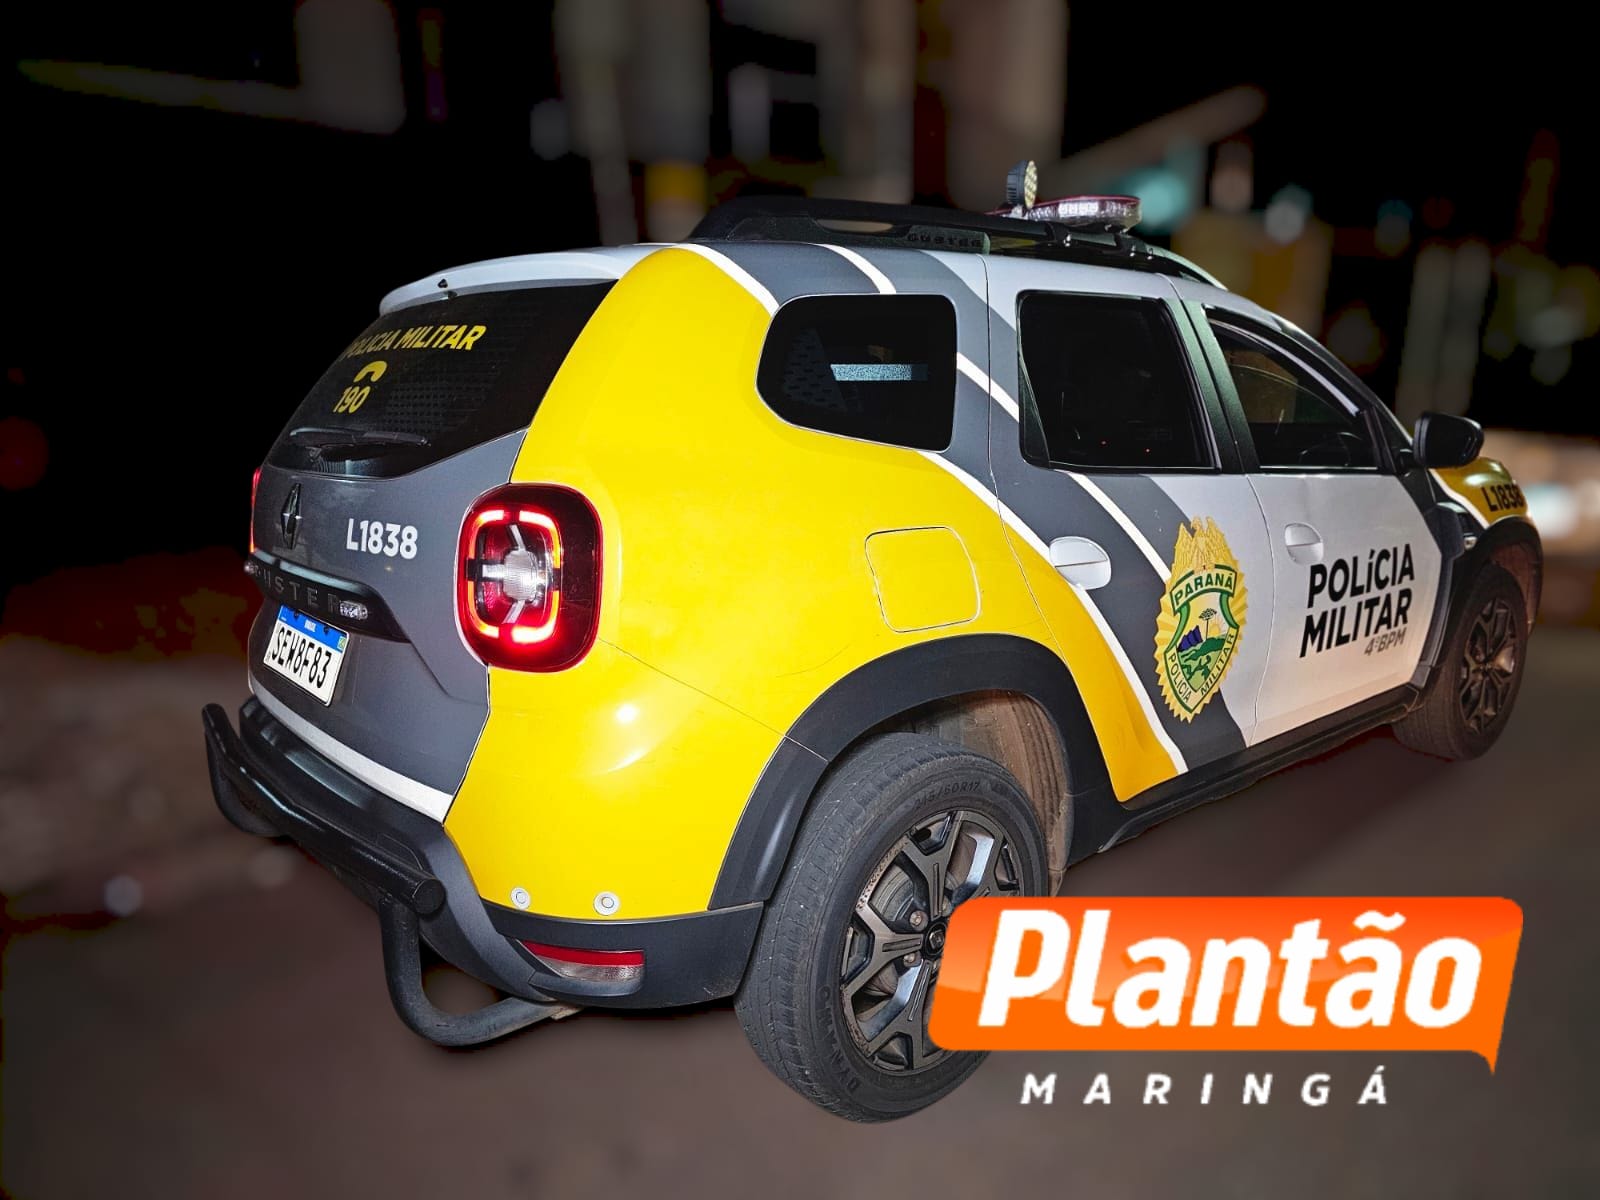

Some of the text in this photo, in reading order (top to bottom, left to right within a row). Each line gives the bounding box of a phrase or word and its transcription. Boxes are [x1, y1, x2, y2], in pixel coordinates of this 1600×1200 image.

[393, 324, 487, 351] MILITAR
[333, 385, 371, 414] 190
[1481, 483, 1525, 512] L1838
[346, 518, 418, 560] L1838
[1172, 572, 1234, 607] PARANÁ
[1307, 543, 1415, 609] POLÍCIA
[1299, 588, 1413, 659] MILITAR
[1200, 632, 1236, 696] MILITAR
